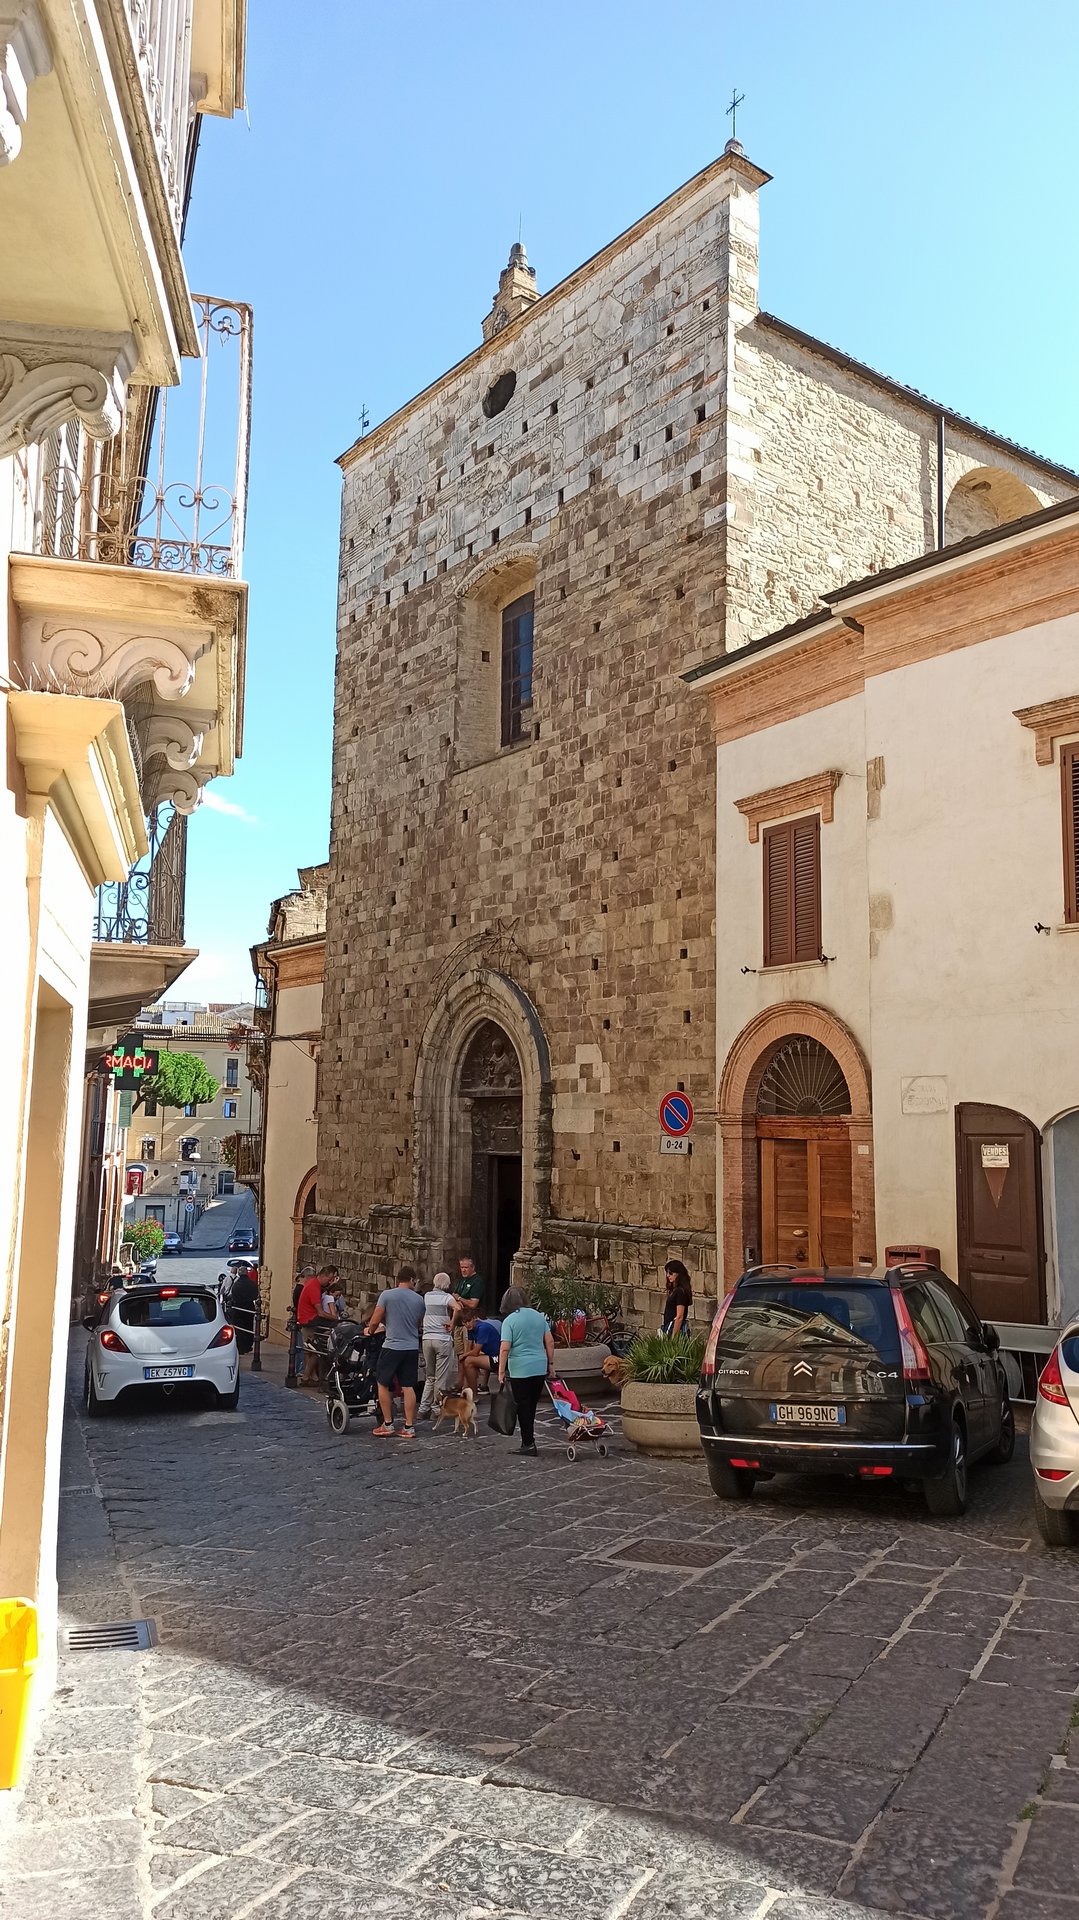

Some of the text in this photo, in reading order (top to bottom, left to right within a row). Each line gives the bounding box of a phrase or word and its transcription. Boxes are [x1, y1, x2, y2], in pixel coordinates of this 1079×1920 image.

[666, 1140, 683, 1150] 0-24
[150, 1369, 160, 1377] EK
[876, 1371, 899, 1379] C4
[778, 1406, 837, 1421] GH 969NC
